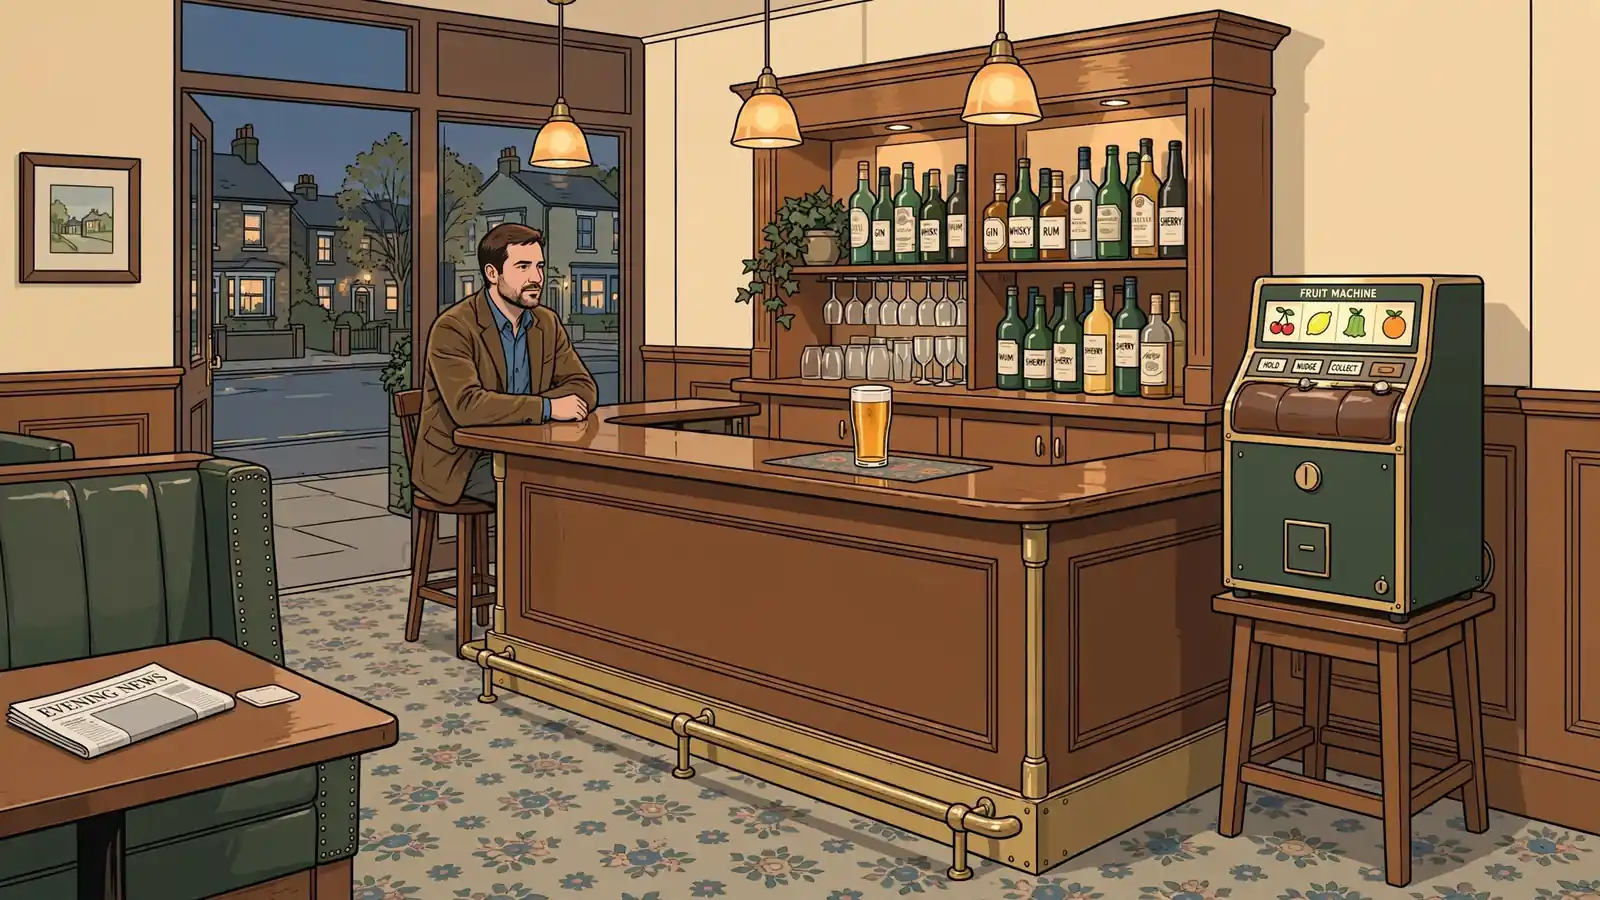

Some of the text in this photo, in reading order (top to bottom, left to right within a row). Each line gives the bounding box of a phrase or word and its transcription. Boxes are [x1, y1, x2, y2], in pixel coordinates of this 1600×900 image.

[1160, 217, 1182, 227] SHERRY
[874, 228, 885, 237] GIN
[985, 227, 999, 237] GIN
[1009, 226, 1032, 236] WHISKY
[1043, 227, 1060, 237] RUM
[1300, 288, 1377, 299] FRUIT MACHINE
[1263, 361, 1280, 370] HOLD
[1297, 362, 1317, 371] NUDGE
[1331, 364, 1358, 373] COLLECT
[36, 672, 168, 718] EVENING NEWS
